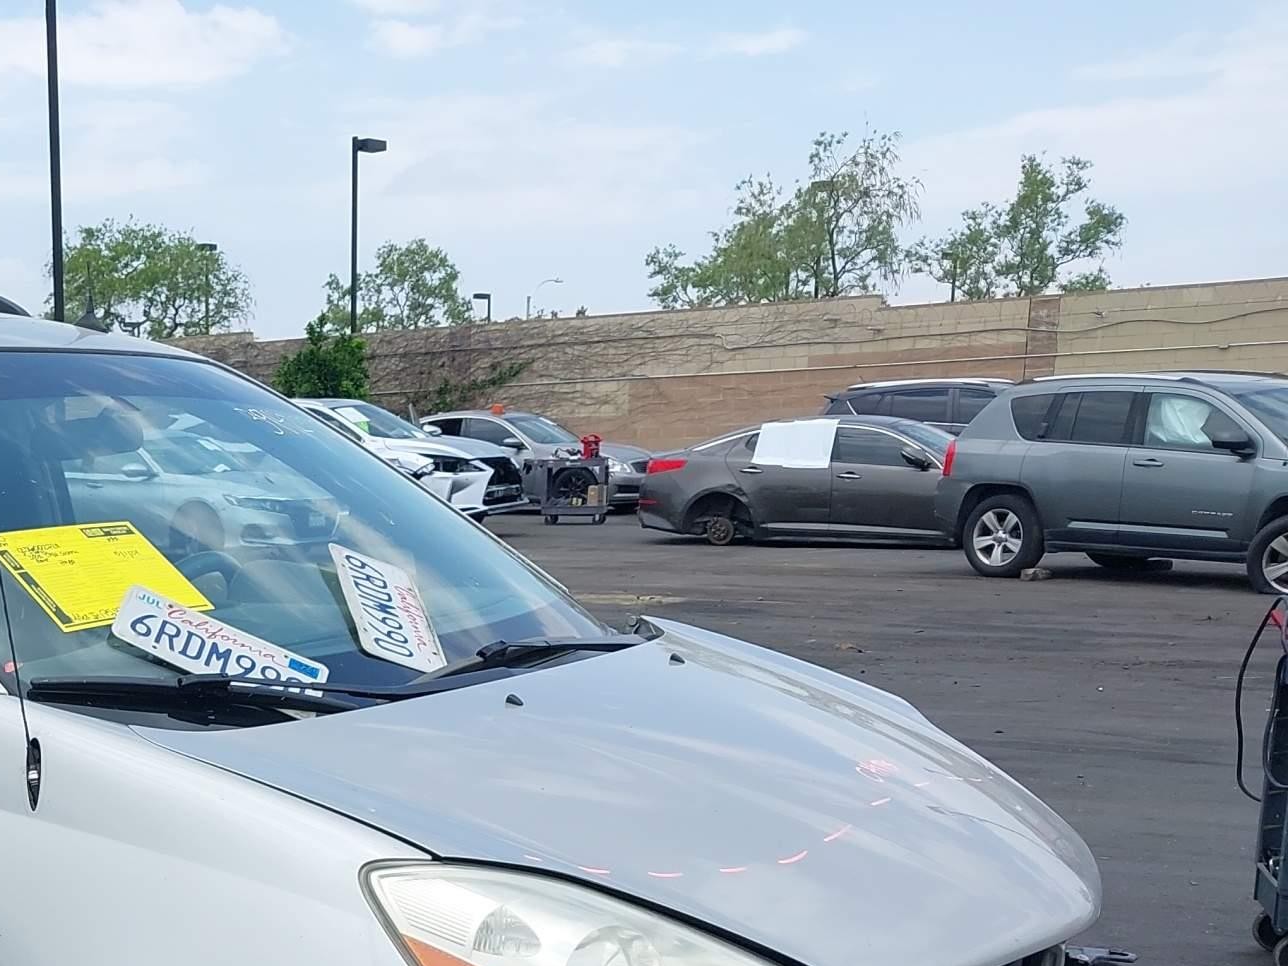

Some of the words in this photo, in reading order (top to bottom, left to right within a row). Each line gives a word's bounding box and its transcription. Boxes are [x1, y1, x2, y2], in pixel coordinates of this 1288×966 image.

[137, 592, 163, 611] JUL
[345, 554, 414, 657] 6RDM990
[394, 585, 427, 653] California
[167, 606, 287, 669] California
